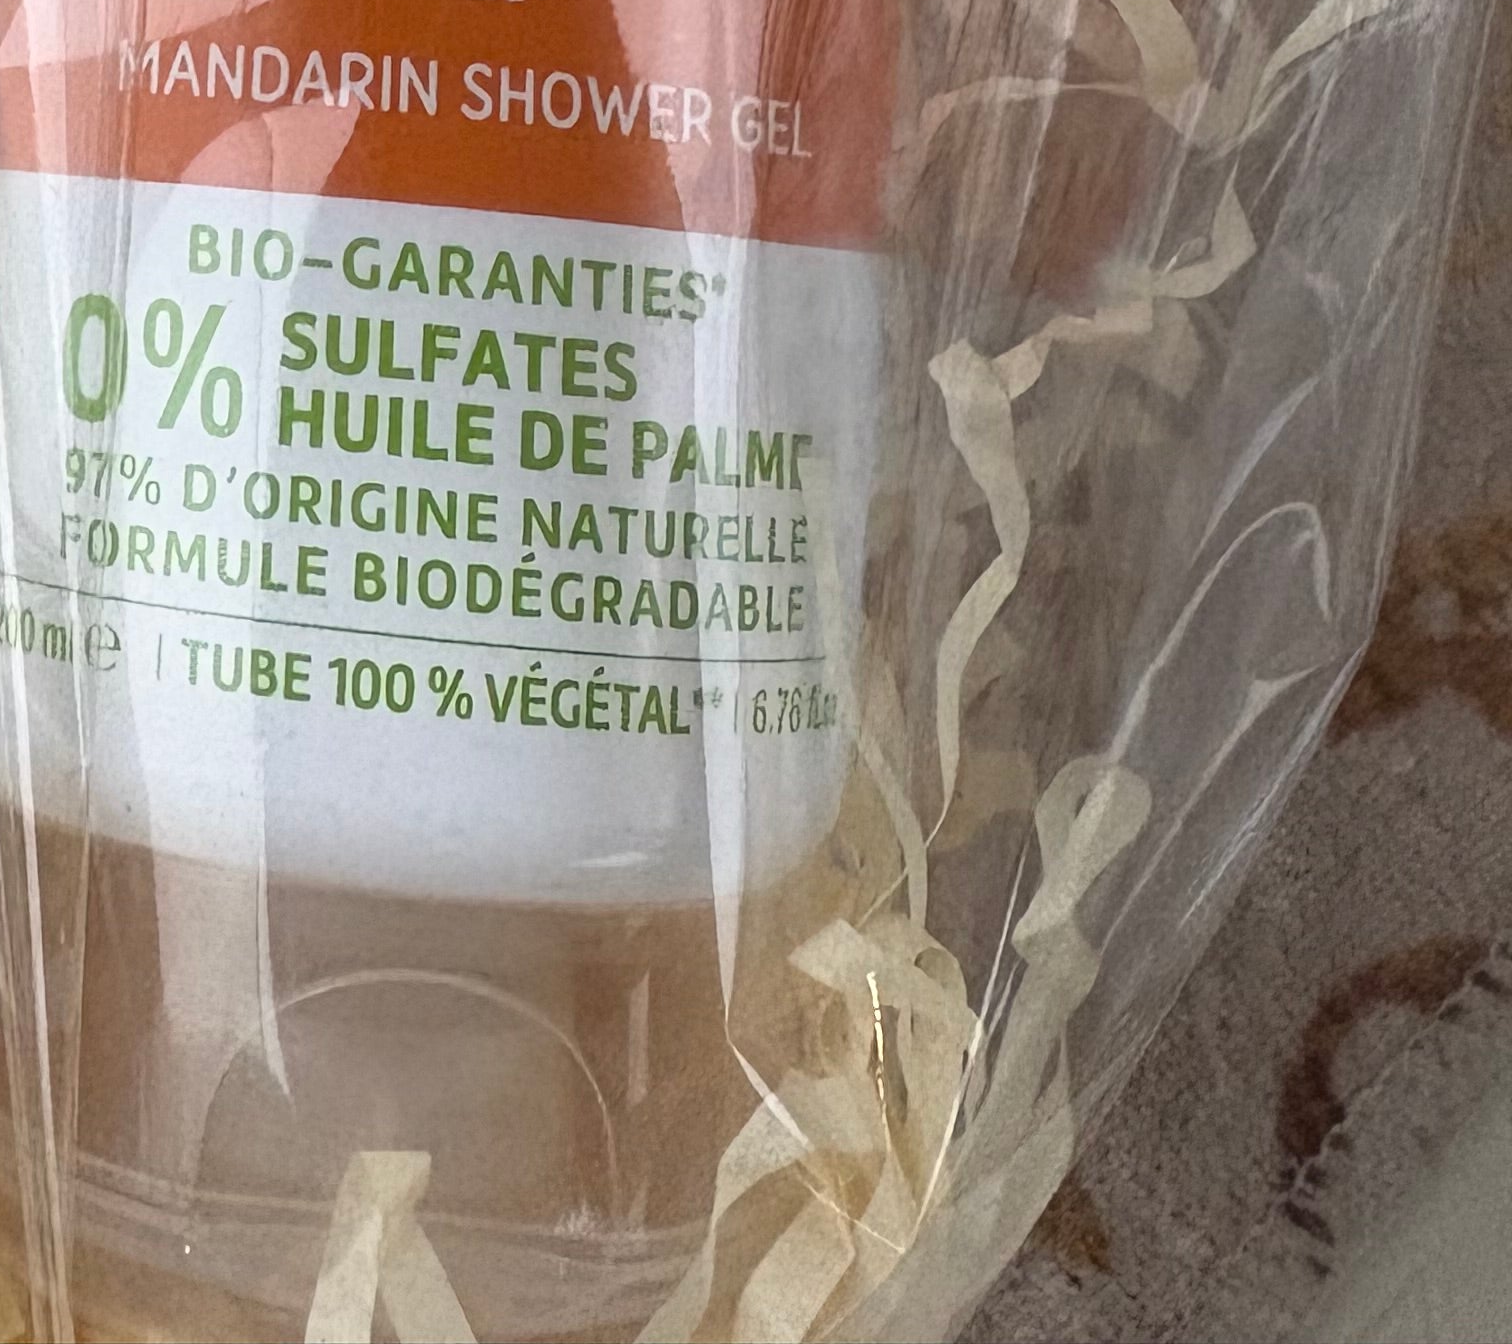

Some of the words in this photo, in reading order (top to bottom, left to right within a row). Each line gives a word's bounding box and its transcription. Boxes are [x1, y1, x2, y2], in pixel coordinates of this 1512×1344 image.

[118, 37, 438, 116] MANDARIN
[459, 62, 713, 147] SHOWER
[731, 95, 813, 159] GEL
[279, 310, 638, 402] SULFATES
[276, 384, 495, 466] HUILE
[519, 409, 609, 477] DE
[182, 463, 499, 544] D'ORIGINE
[521, 496, 808, 564] NATURELLE
[60, 511, 329, 597] FORMULE
[353, 551, 805, 634] BIODÉGRADABLE
[181, 637, 313, 702] TUBE
